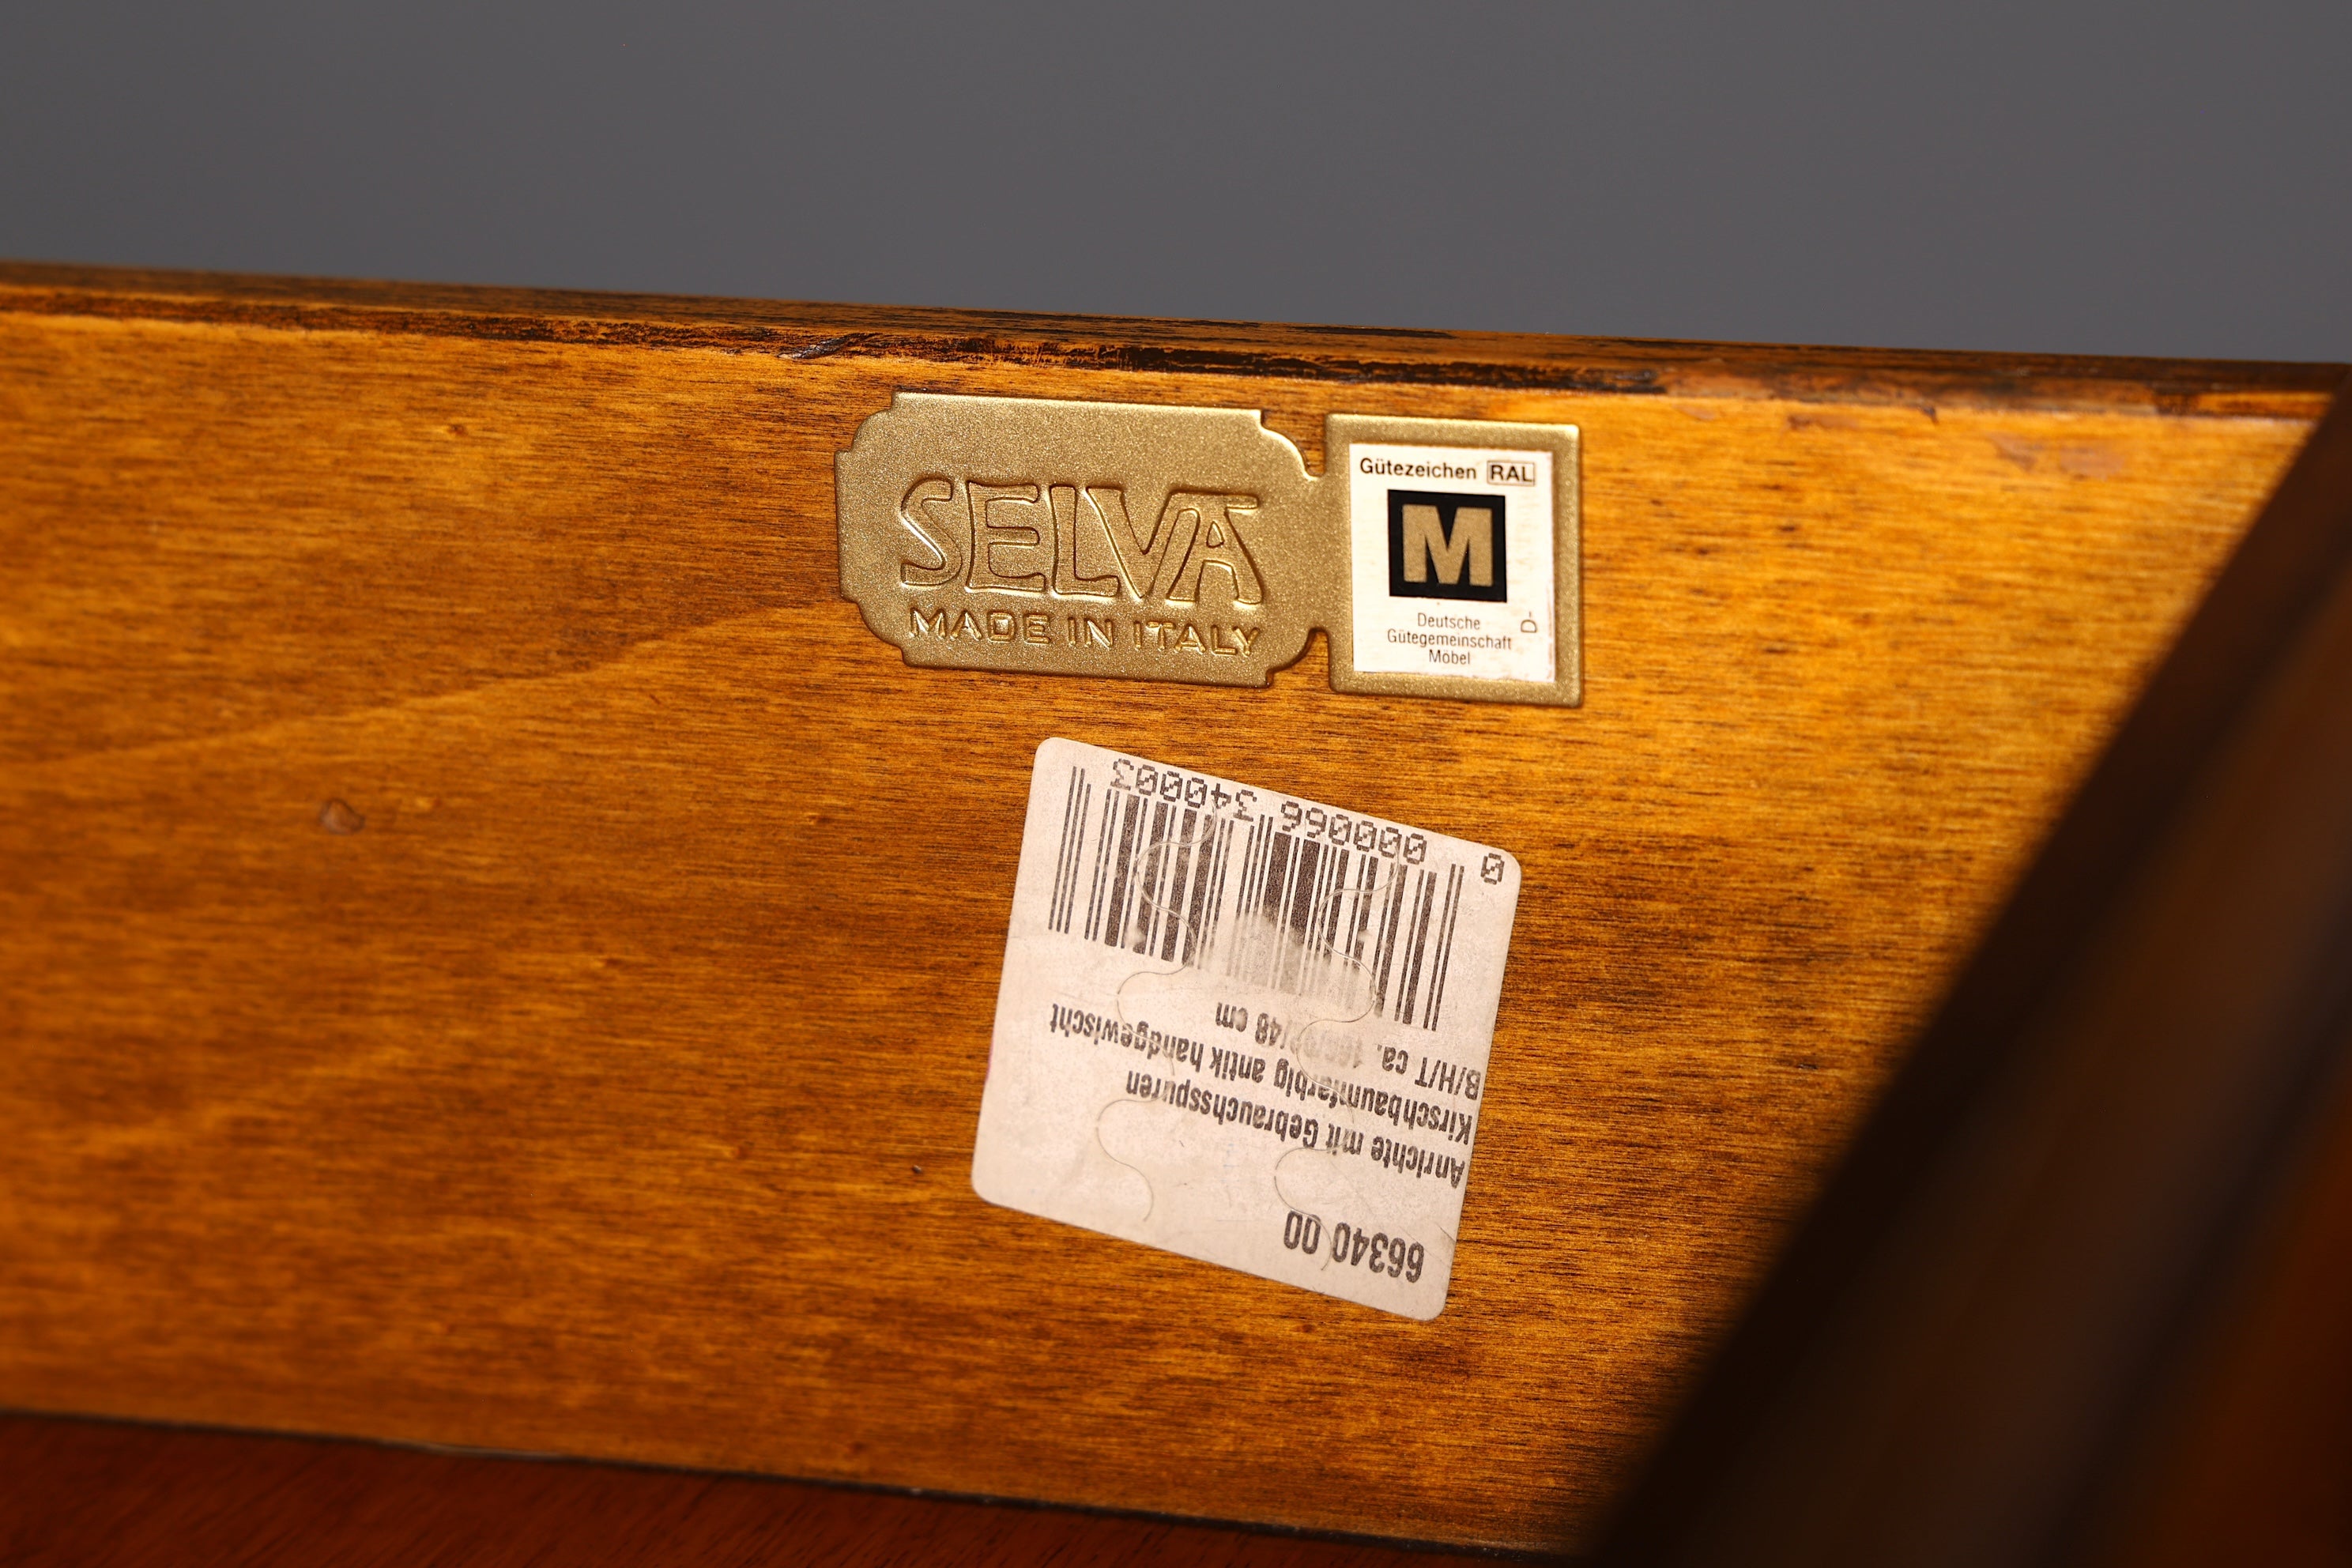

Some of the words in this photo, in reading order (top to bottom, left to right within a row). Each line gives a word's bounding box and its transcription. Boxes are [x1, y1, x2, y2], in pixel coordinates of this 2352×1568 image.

[1359, 457, 1477, 480] Gütezeichen
[1491, 464, 1533, 483] RAL
[900, 477, 1267, 606] SELVA
[1401, 503, 1494, 588] M
[909, 607, 1052, 645] MADE
[1068, 615, 1115, 650] IN
[1133, 620, 1261, 657] ITALY
[1387, 628, 1512, 650] Gütegemeinschaft
[1417, 612, 1480, 631] Deutsche
[1428, 649, 1471, 665] Möbel
[1109, 758, 1258, 823] 340003
[1280, 800, 1428, 865] 000066
[1480, 853, 1505, 886] 0
[1050, 1003, 1204, 1072] handgewischt
[1215, 1001, 1249, 1033] cm
[1208, 1046, 1266, 1084] antik
[1377, 1043, 1409, 1075] ca.
[1415, 1057, 1482, 1101] B/H/T
[1125, 1069, 1319, 1149] Gebrauchsspuren
[1273, 1057, 1473, 1145] Kirschbaumfarbig
[1325, 1122, 1365, 1156] mit
[1370, 1136, 1465, 1189] Anrichte
[1283, 1210, 1321, 1255] 00
[1331, 1221, 1425, 1283] 66340
